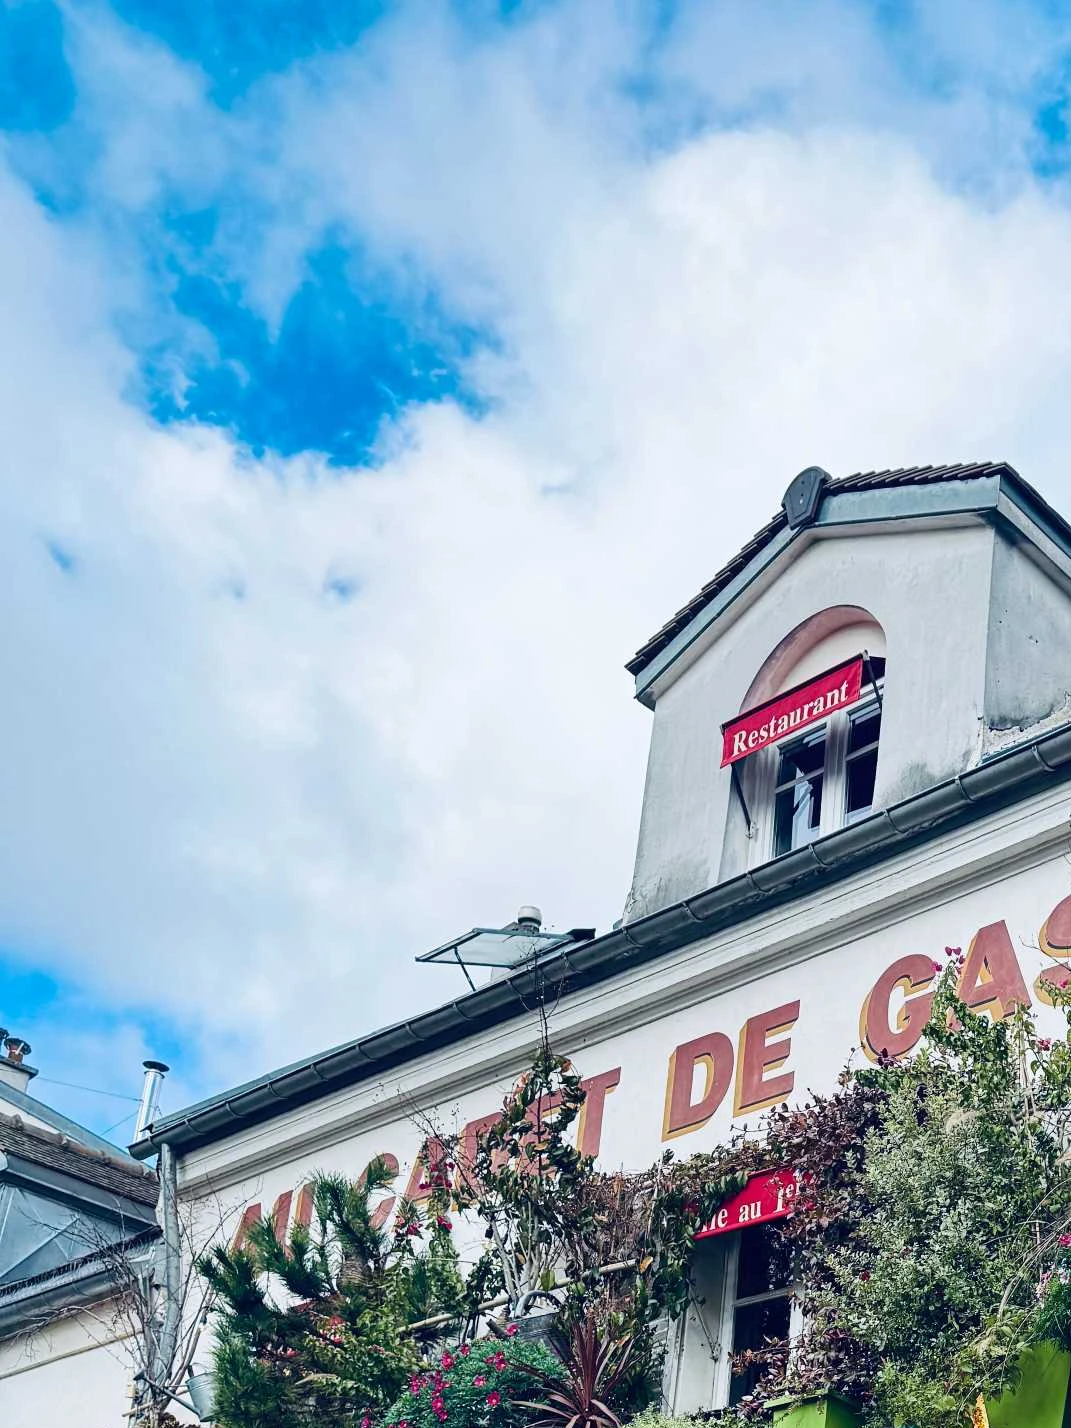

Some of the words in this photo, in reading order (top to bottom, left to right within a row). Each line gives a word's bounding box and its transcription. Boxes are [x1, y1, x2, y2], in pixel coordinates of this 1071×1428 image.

[732, 680, 848, 757] Restaurant
[661, 1000, 801, 1142] DE
[739, 1200, 762, 1223] au
